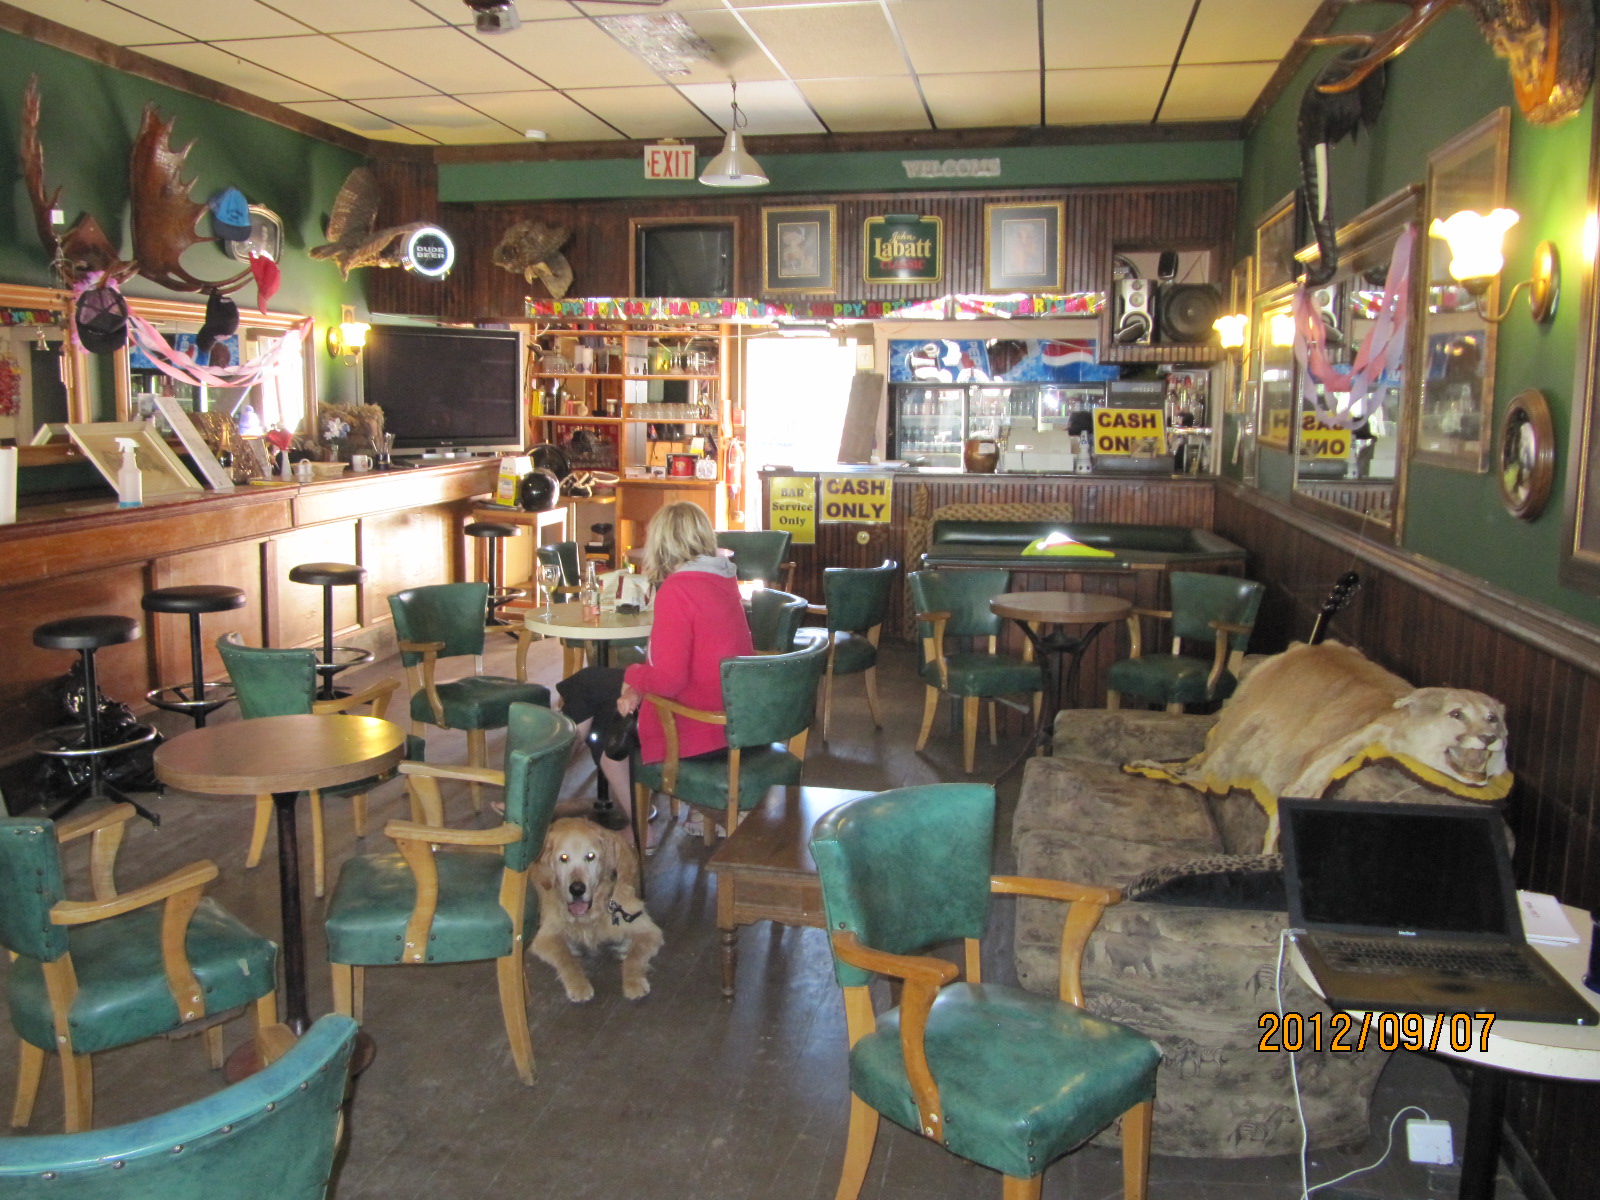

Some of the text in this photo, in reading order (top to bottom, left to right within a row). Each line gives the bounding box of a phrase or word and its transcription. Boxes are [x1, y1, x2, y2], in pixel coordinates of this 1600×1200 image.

[651, 150, 692, 177] EXIT
[889, 231, 913, 242] John
[416, 245, 445, 253] DUDE
[873, 237, 931, 261] Labatt
[534, 301, 580, 316] HAPPY
[669, 301, 718, 316] HAPPY
[721, 301, 794, 316] BIRTHDAY
[811, 302, 863, 317] HAPPY
[1098, 412, 1156, 428] CASH
[781, 488, 804, 497] BAR
[826, 480, 885, 495] CASH
[772, 502, 813, 511] Service
[826, 503, 885, 518] ONLY
[779, 516, 806, 526] Only
